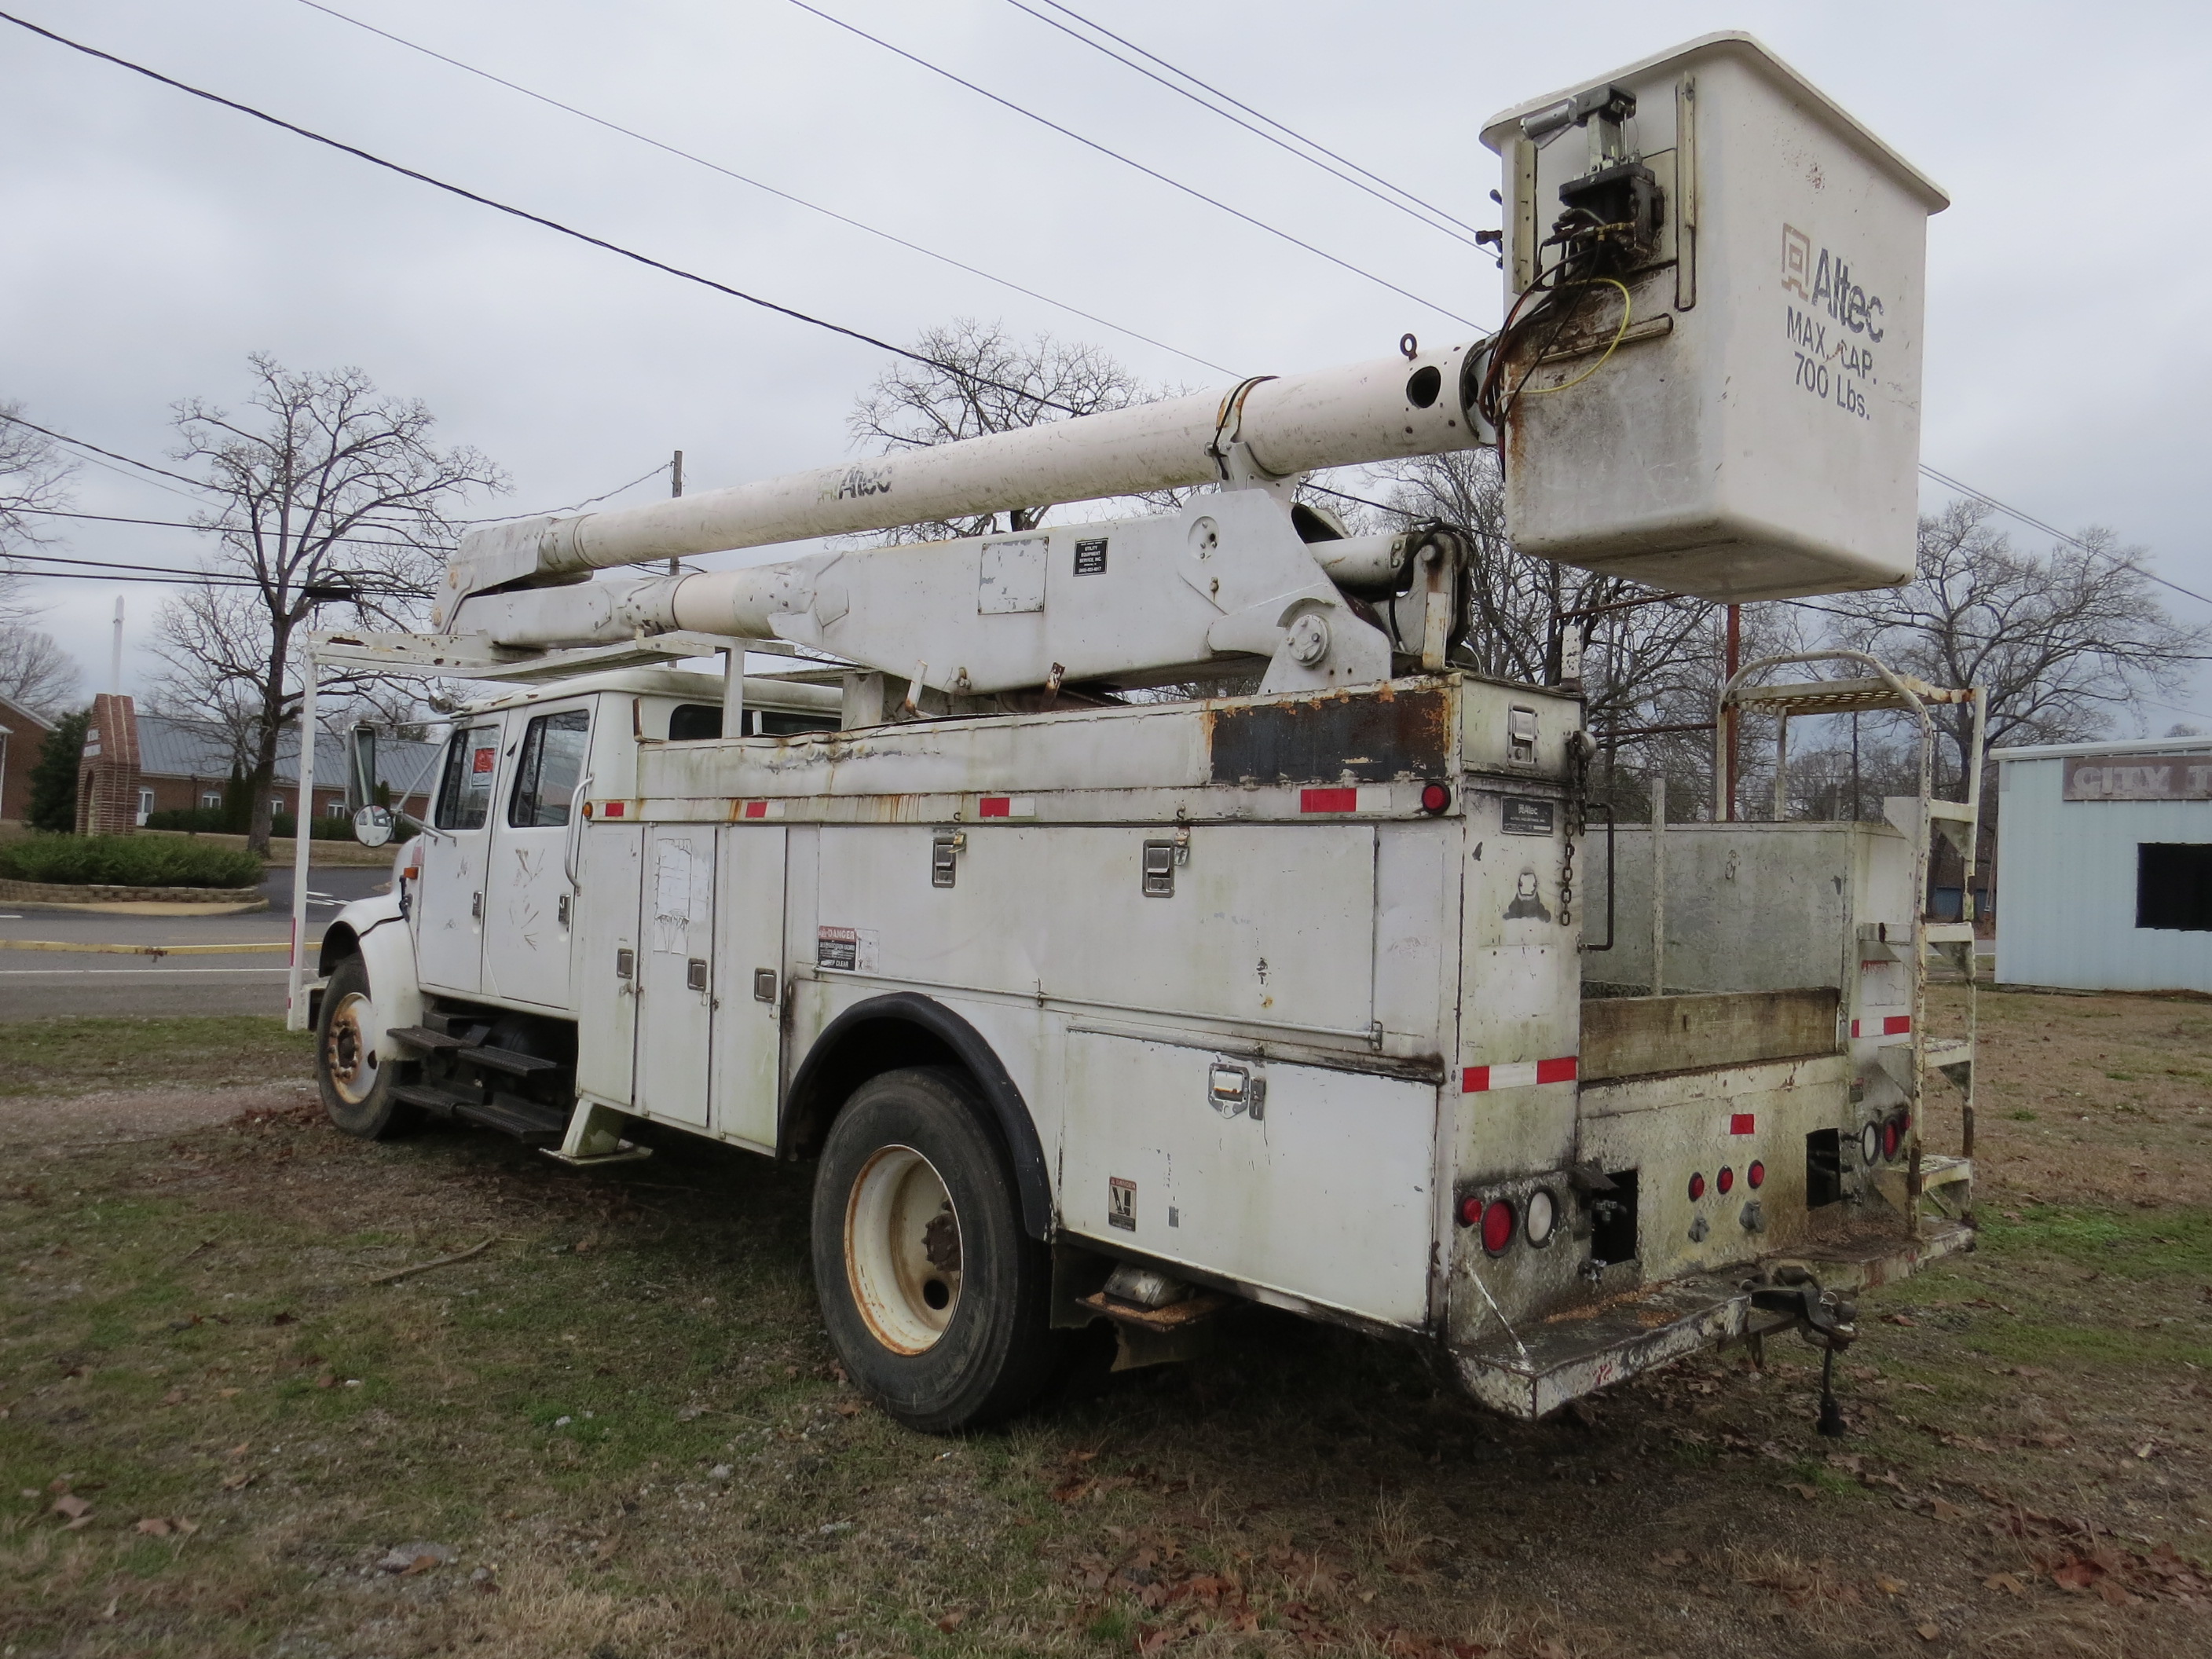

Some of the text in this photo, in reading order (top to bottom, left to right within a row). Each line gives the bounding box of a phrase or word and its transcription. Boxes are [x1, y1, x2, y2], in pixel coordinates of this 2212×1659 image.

[1811, 247, 1884, 343] Altec
[1794, 350, 1870, 420] 700 Lbs.
[2073, 765, 2171, 796] CITY
[828, 928, 855, 940] DANGER
